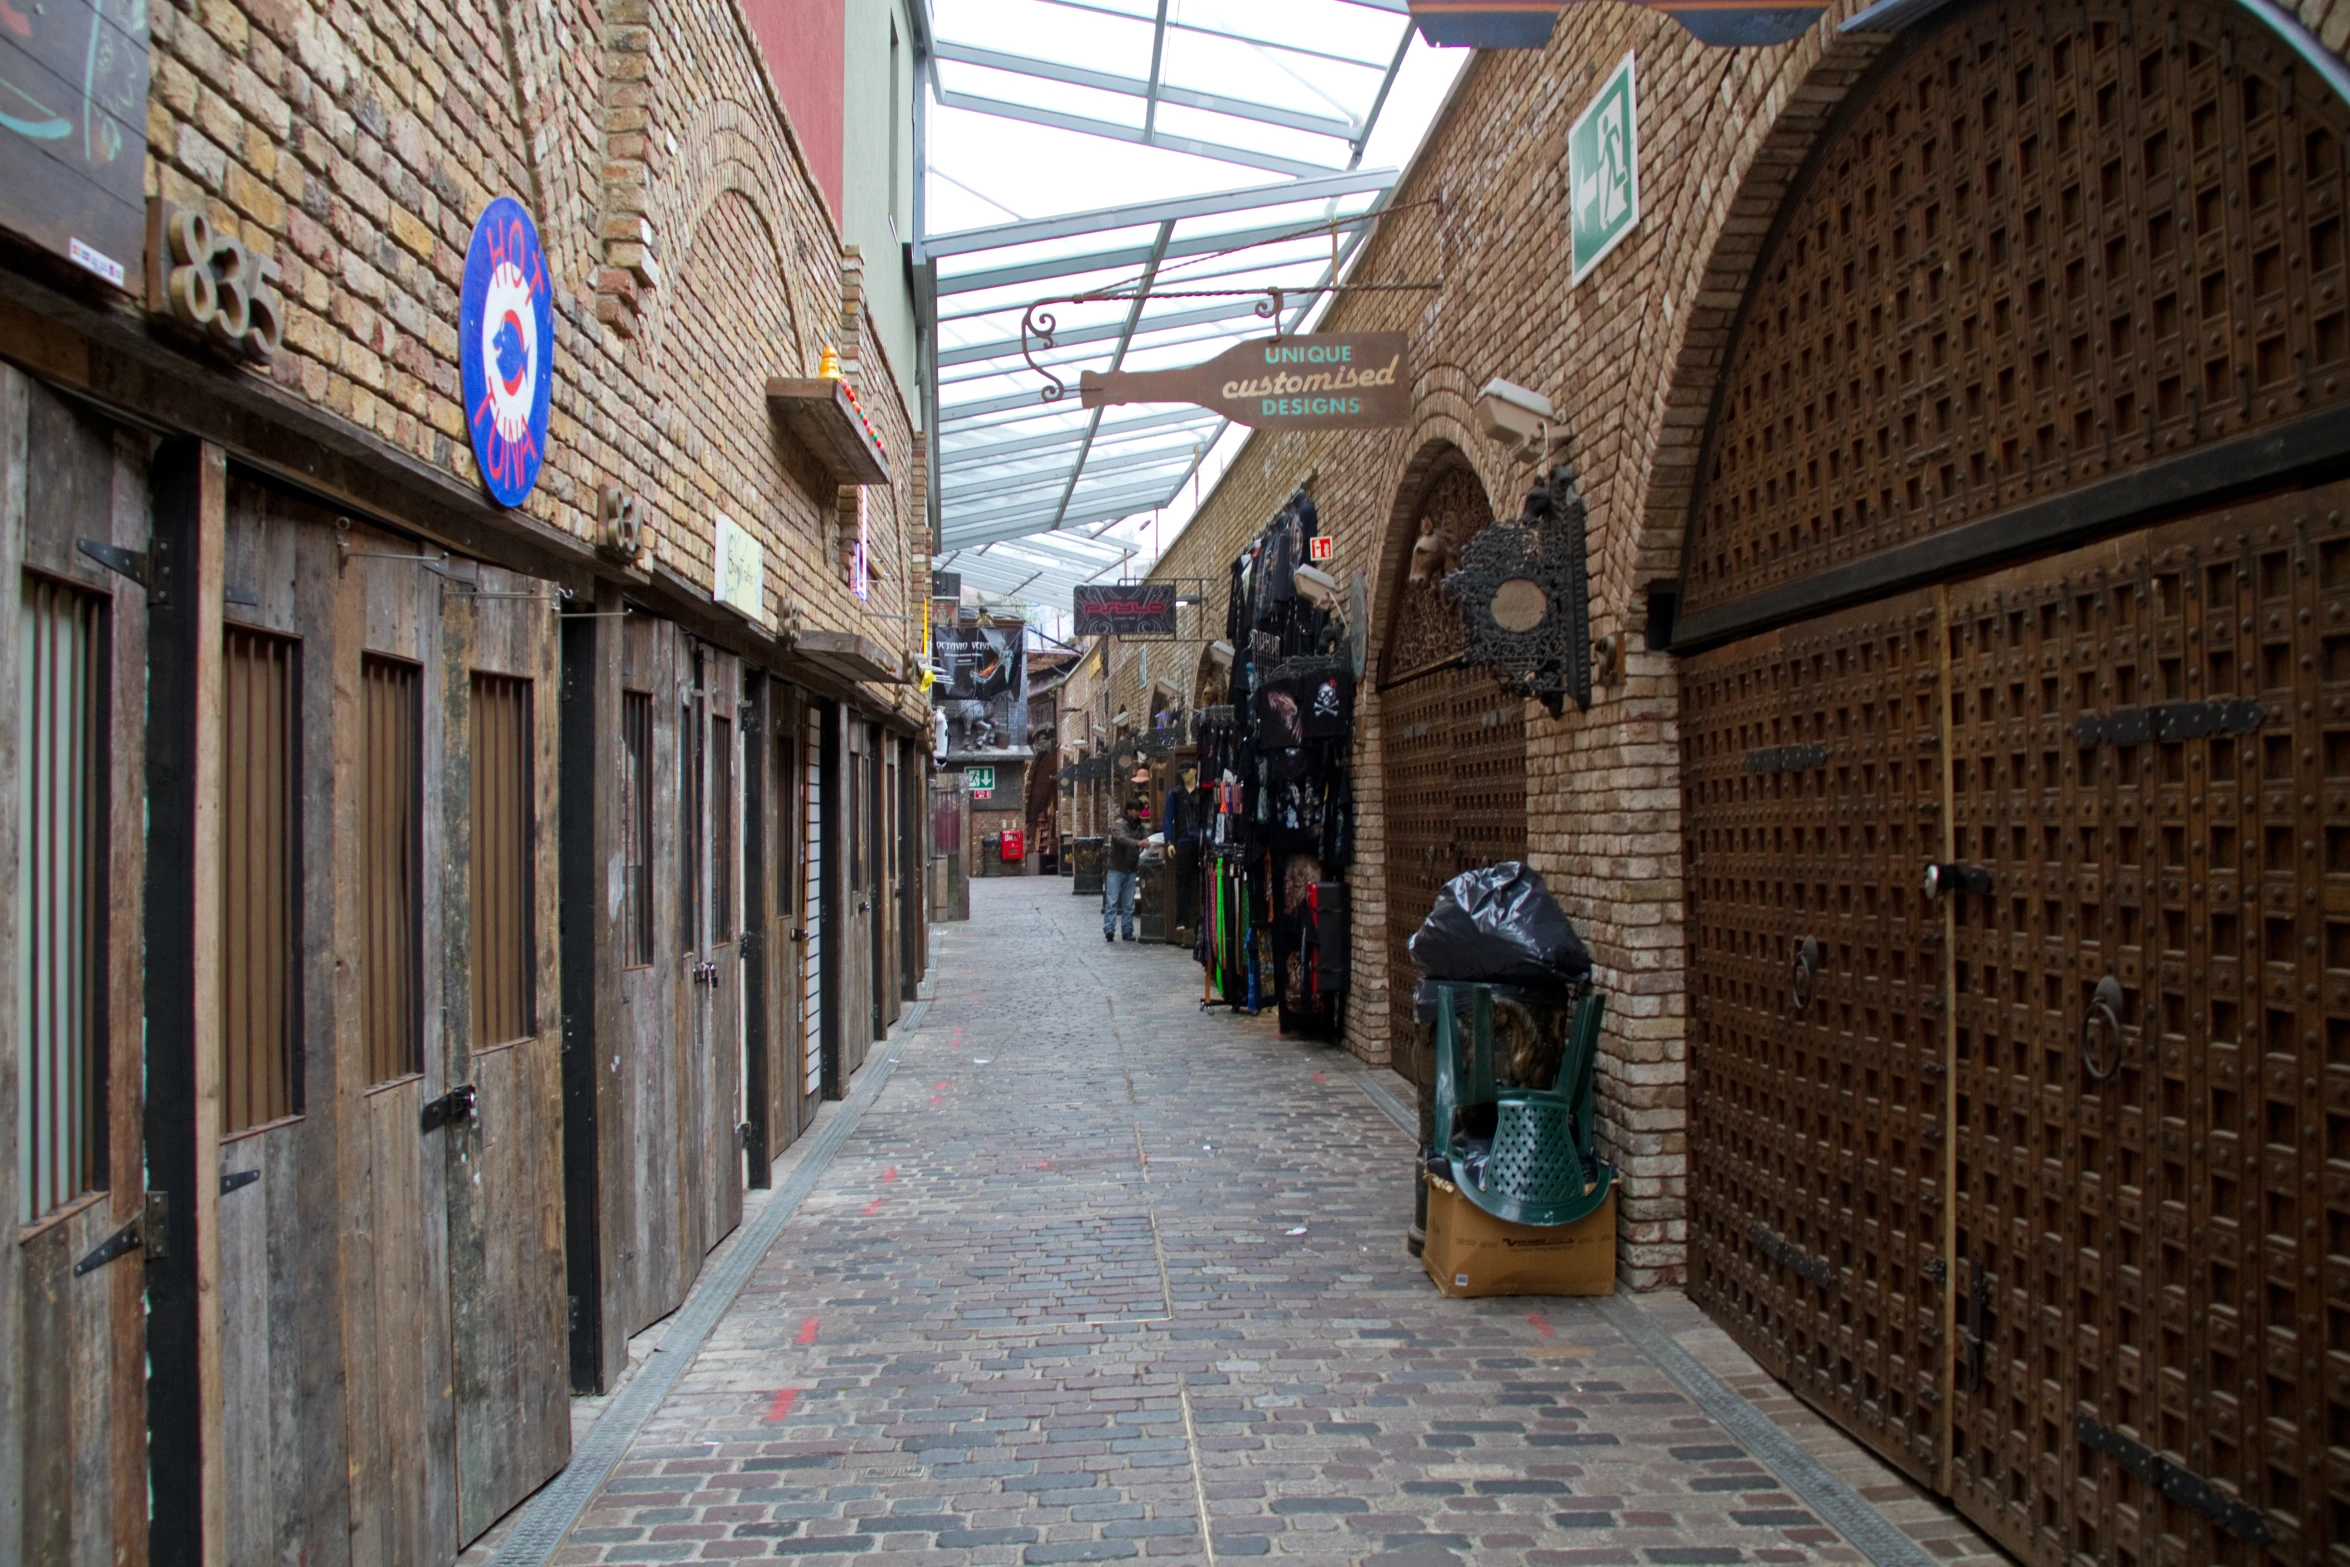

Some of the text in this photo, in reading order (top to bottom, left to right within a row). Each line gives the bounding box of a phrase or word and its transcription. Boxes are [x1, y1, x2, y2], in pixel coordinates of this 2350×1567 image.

[169, 210, 282, 356] 835
[1265, 345, 1352, 364] UNIQUE
[1222, 354, 1399, 399] customised
[1262, 397, 1360, 416] DESIGNS
